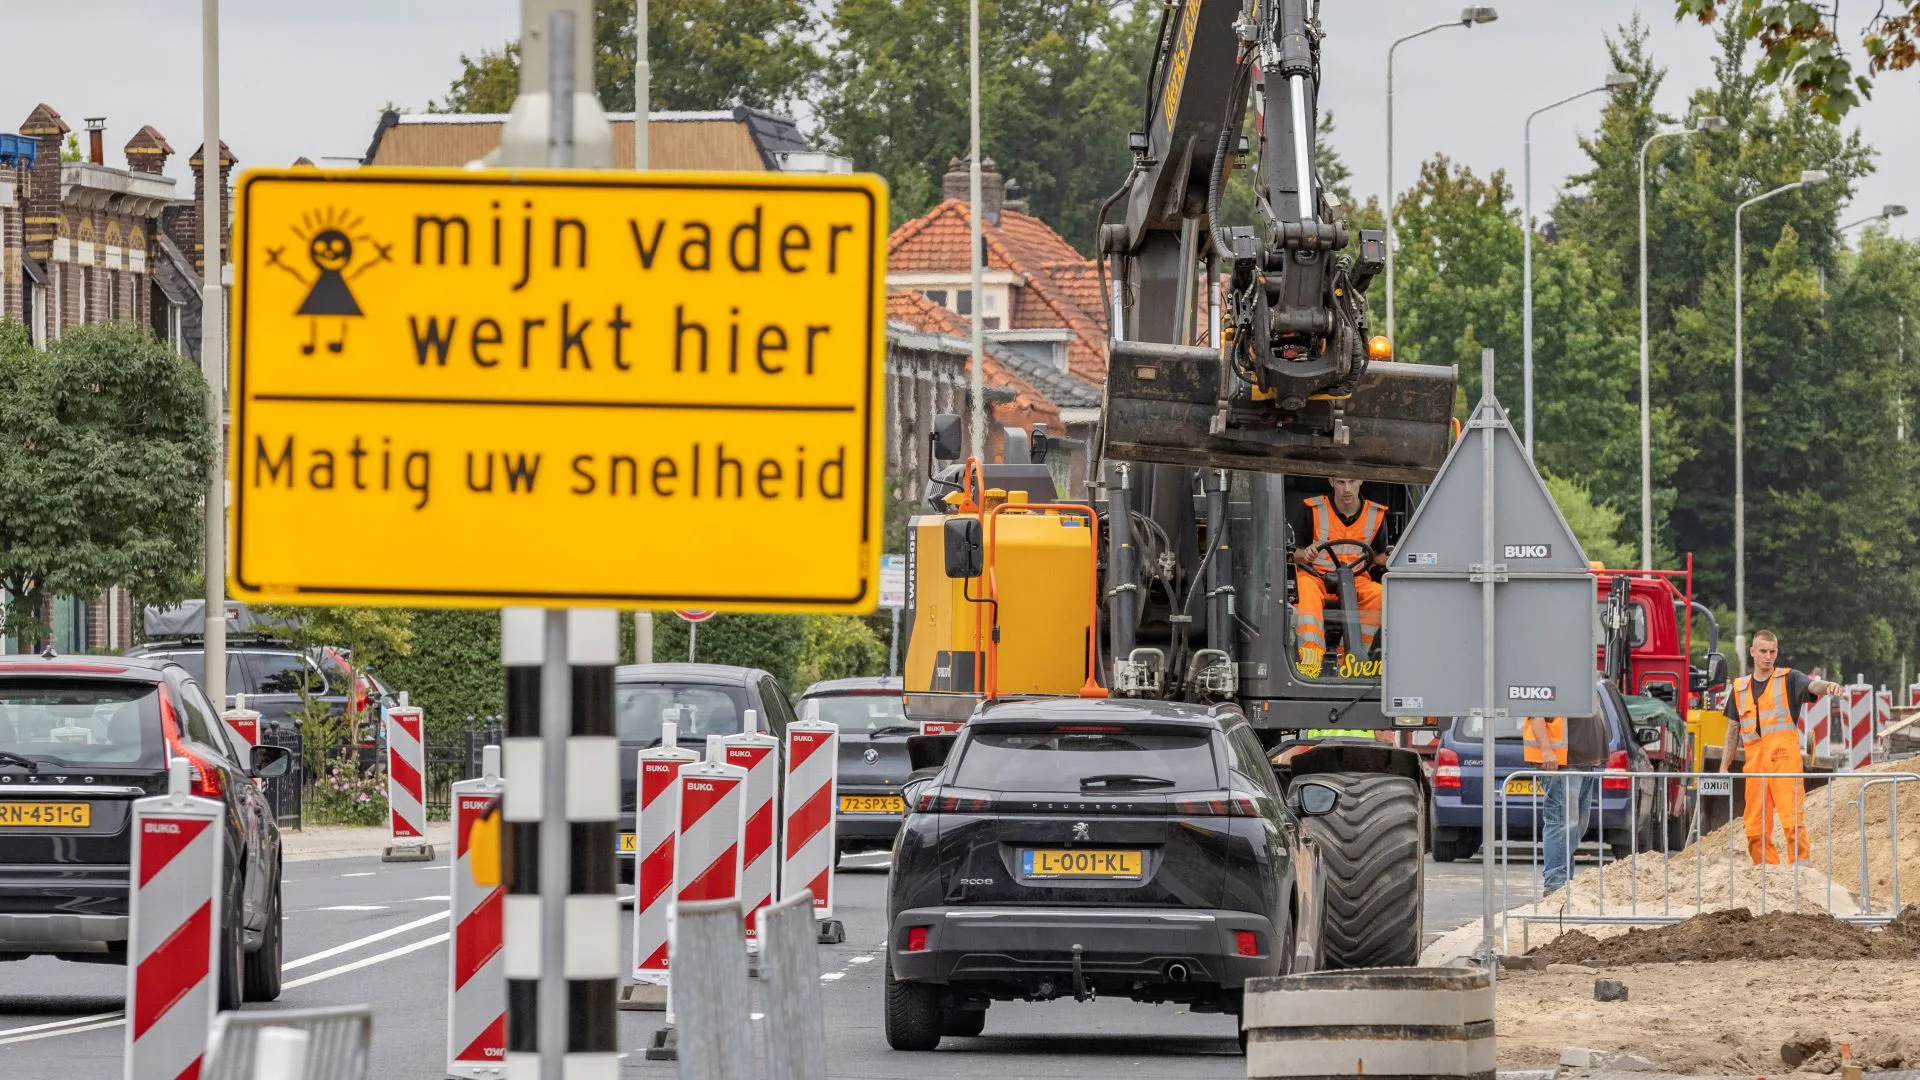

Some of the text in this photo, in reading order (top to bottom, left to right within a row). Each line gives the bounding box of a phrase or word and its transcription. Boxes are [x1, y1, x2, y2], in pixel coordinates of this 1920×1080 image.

[414, 200, 853, 291] mijn vader
[410, 302, 831, 375] werkt hier
[254, 435, 845, 510] Matig uw snelheid
[1339, 653, 1383, 678] Sven
[0, 775, 94, 784] OLVO
[1507, 782, 1543, 793] 20-GX
[845, 798, 900, 810] 72-SPX-5
[0, 806, 83, 823] RN-451-G
[1042, 854, 1131, 872] L-001-KL
